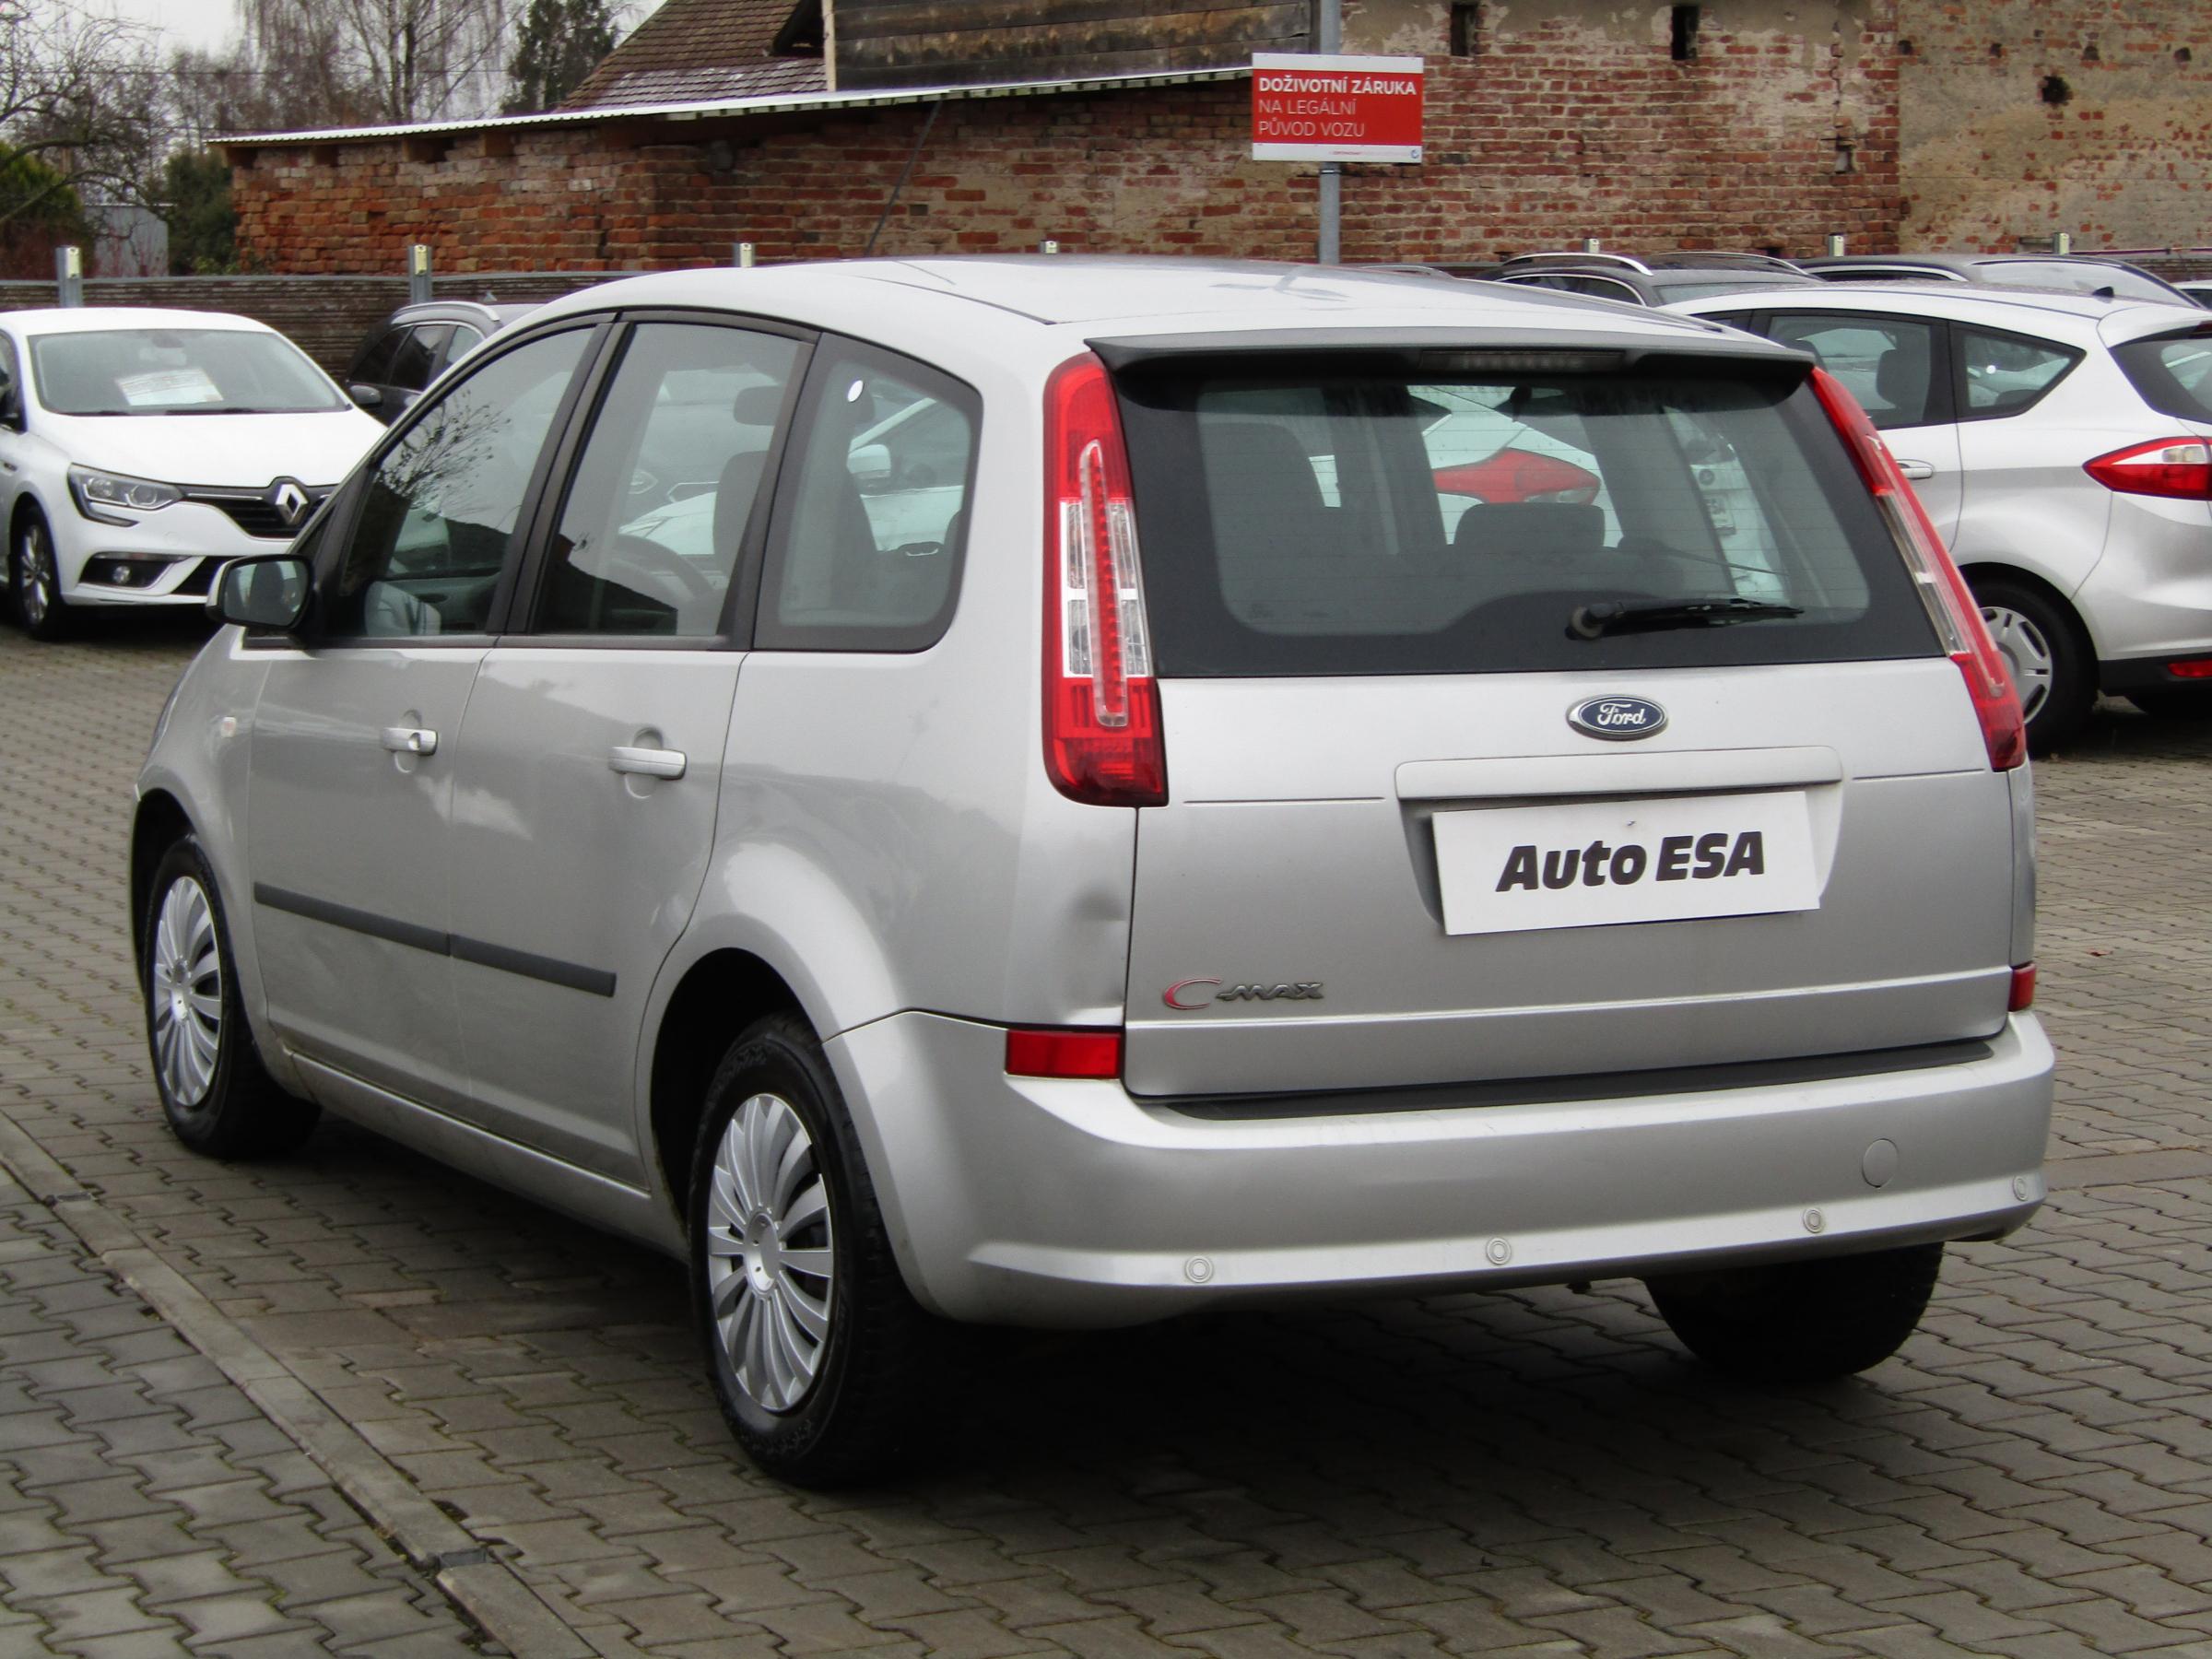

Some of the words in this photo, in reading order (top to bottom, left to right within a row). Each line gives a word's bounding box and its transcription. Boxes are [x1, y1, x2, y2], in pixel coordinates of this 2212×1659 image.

[1259, 74, 1347, 94] DOŽIVOTNÍ
[1351, 76, 1417, 95] ZÁRUKA
[1258, 99, 1283, 113] NA
[1287, 97, 1357, 115] LEGÁLNÍ
[1258, 117, 1316, 136] PŮVOD
[1320, 121, 1365, 137] VOZU
[1596, 701, 1647, 726] Ford
[1495, 840, 1648, 892] Auto
[1655, 830, 1765, 882] ESA
